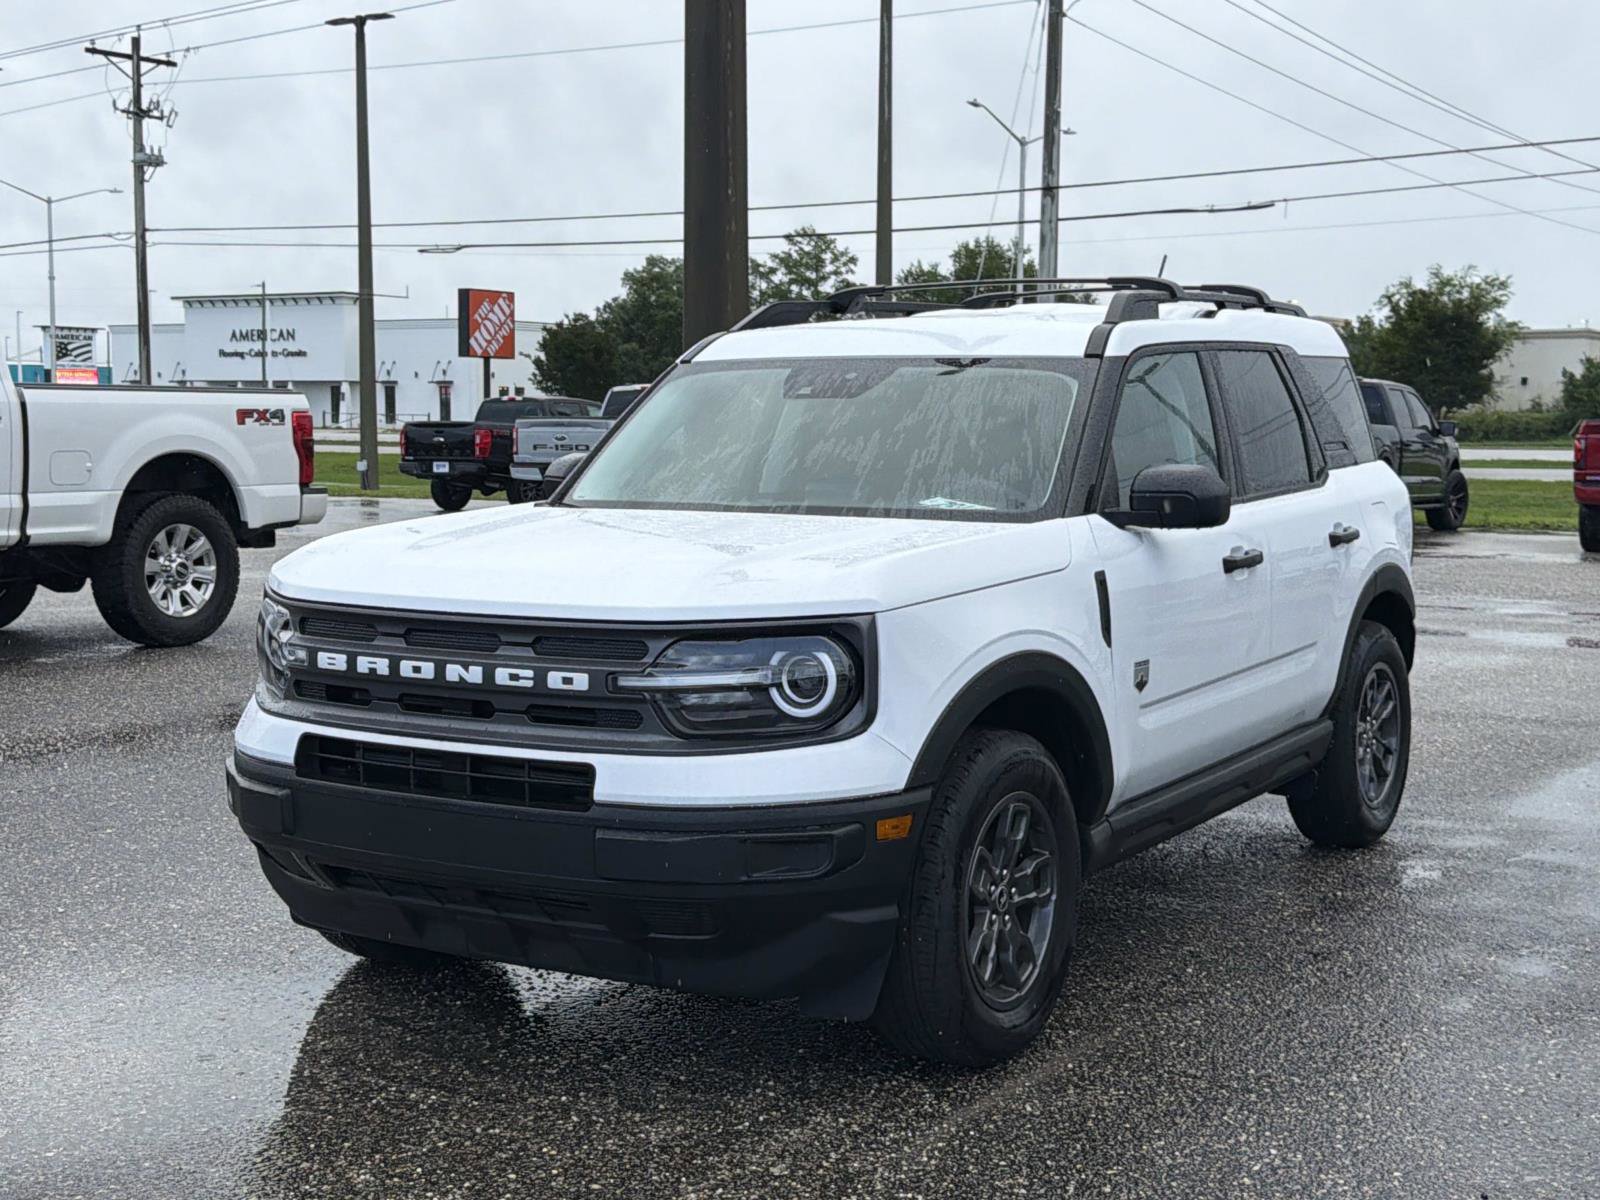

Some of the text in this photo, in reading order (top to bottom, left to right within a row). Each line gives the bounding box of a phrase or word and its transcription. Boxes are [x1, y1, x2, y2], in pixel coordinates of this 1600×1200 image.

[469, 293, 513, 357] HOME
[229, 328, 295, 342] AMERICAN
[236, 408, 285, 425] FX4
[533, 443, 590, 451] F-150
[317, 651, 590, 692] BRONCO
